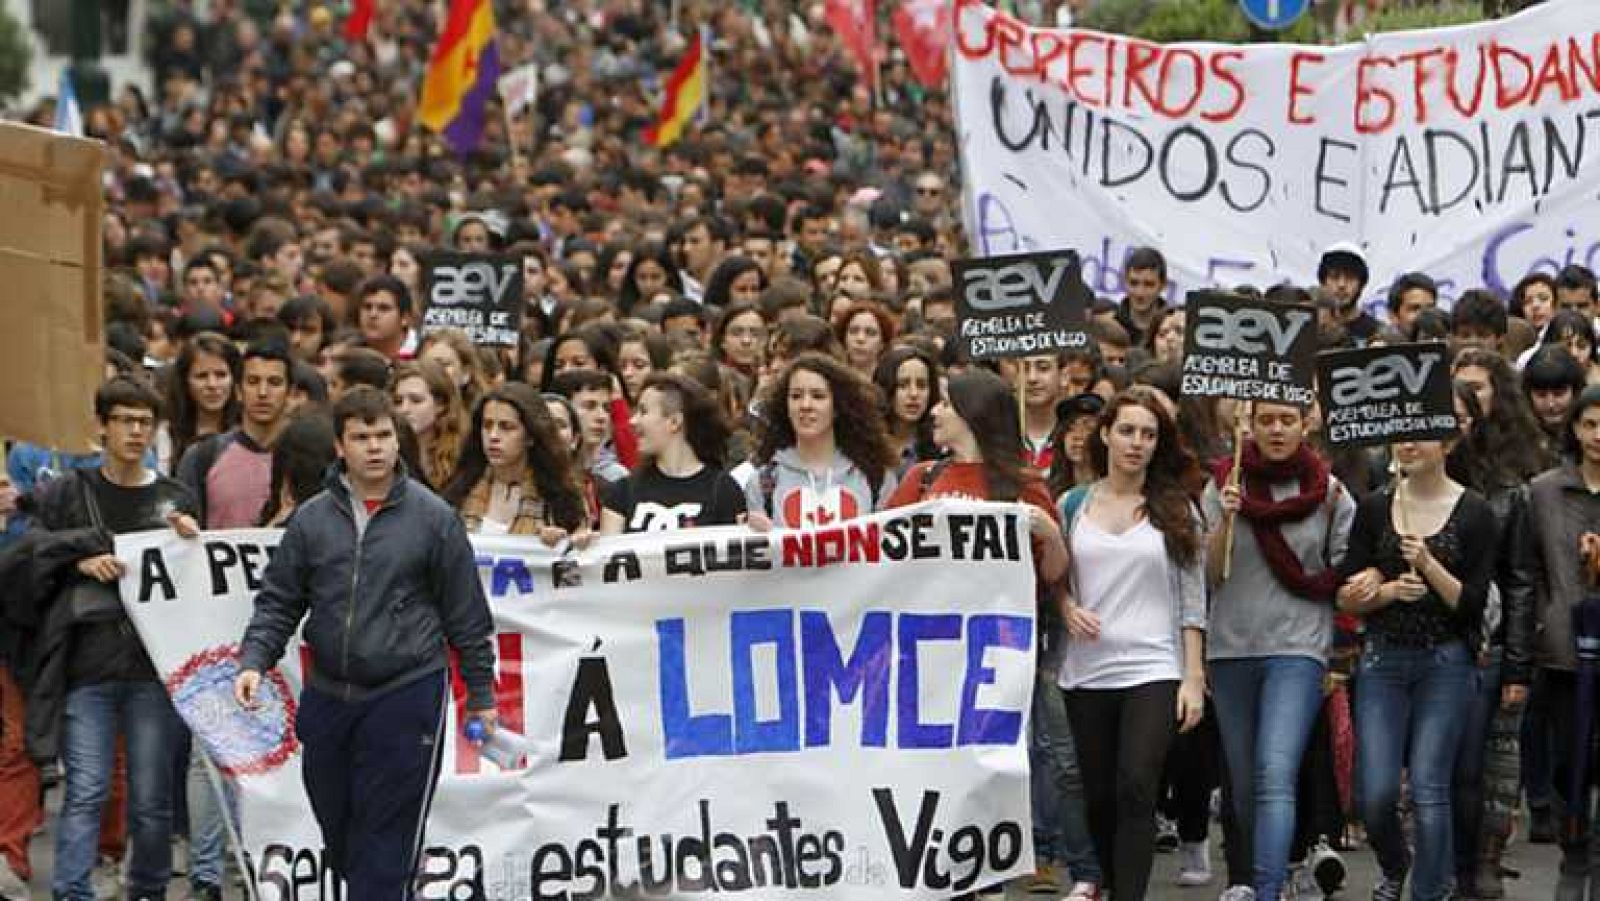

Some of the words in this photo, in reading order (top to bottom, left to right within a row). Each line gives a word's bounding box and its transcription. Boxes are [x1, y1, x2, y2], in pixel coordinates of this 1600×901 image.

[1287, 53, 1325, 124] E
[990, 76, 1276, 214] UNIDOS
[1315, 137, 1358, 222] E
[963, 258, 1069, 310] aev
[1195, 306, 1312, 356] aev
[1268, 361, 1293, 380] DE
[1330, 352, 1441, 405] aev
[139, 547, 176, 602] A
[206, 541, 276, 596] PE
[603, 549, 641, 584] A
[666, 537, 772, 577] QUE
[782, 522, 881, 569] NON
[880, 515, 940, 562] SE
[947, 514, 1021, 561] FAI
[558, 636, 629, 762] Á
[655, 608, 1034, 761] LOMCE
[530, 799, 845, 901] estudantes
[871, 787, 1023, 892] Vigo
